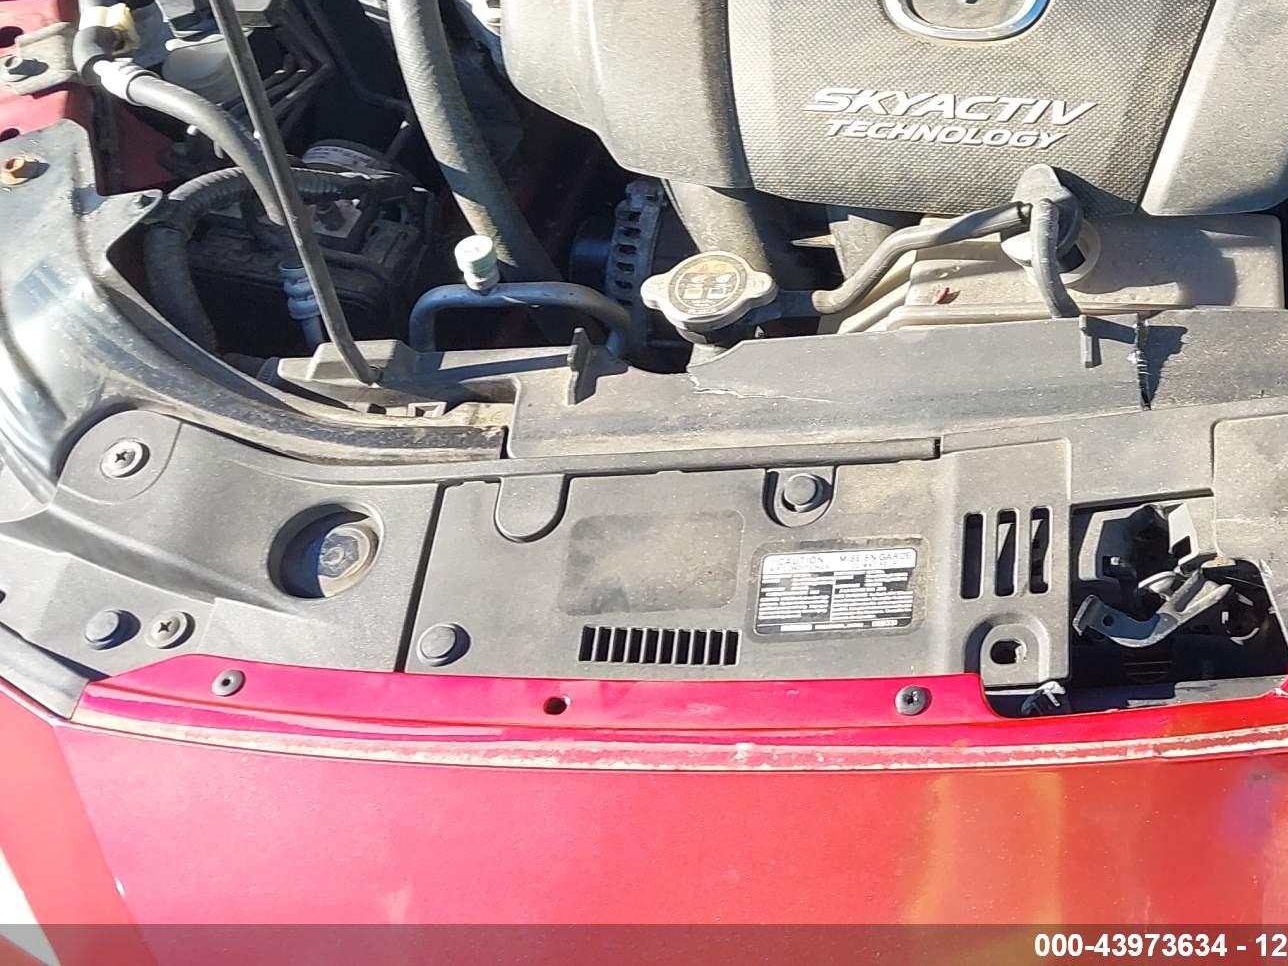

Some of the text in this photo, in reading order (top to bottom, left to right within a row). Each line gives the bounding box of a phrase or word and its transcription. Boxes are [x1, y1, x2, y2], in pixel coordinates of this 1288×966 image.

[803, 87, 1099, 126] SKYACTIV
[825, 120, 1068, 150] TECHNOLOGY
[778, 555, 825, 566] CAUTION
